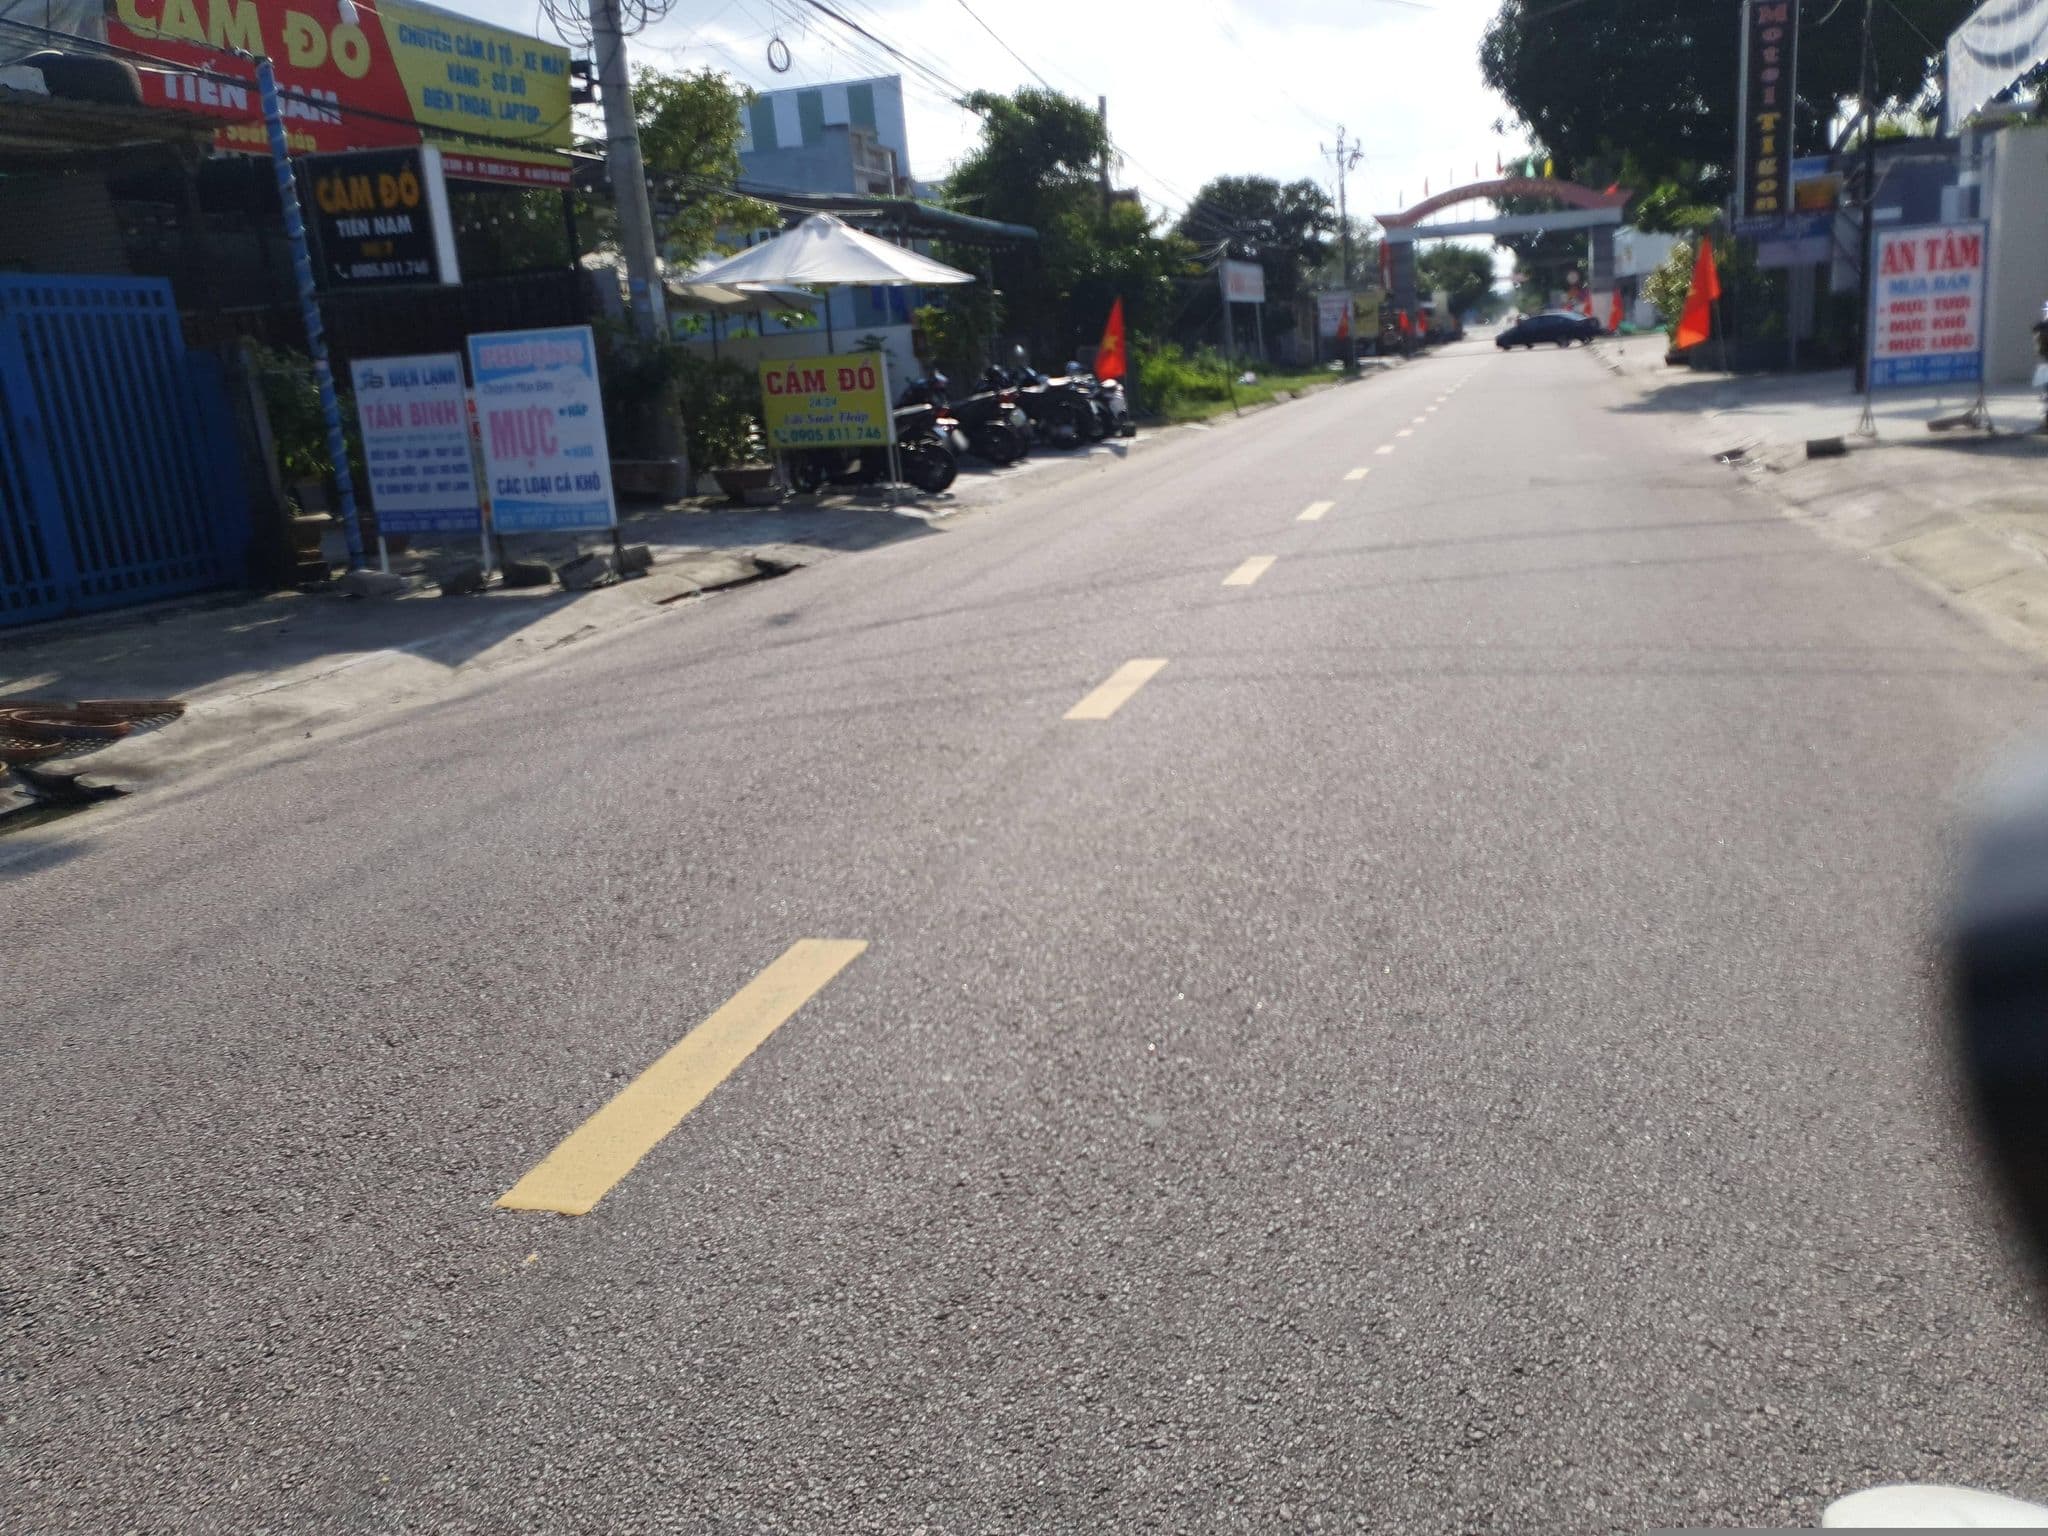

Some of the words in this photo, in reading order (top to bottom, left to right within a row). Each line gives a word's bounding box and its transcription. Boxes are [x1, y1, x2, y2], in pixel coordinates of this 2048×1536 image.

[373, 214, 413, 237] NAM
[1881, 240, 1916, 276] AN
[1925, 229, 1980, 272] TÂM
[488, 403, 560, 470] MỰC
[497, 474, 522, 496] CÁC
[524, 475, 552, 497] LOẠI
[555, 472, 572, 492] CÁ
[575, 469, 601, 491] KHÔ
